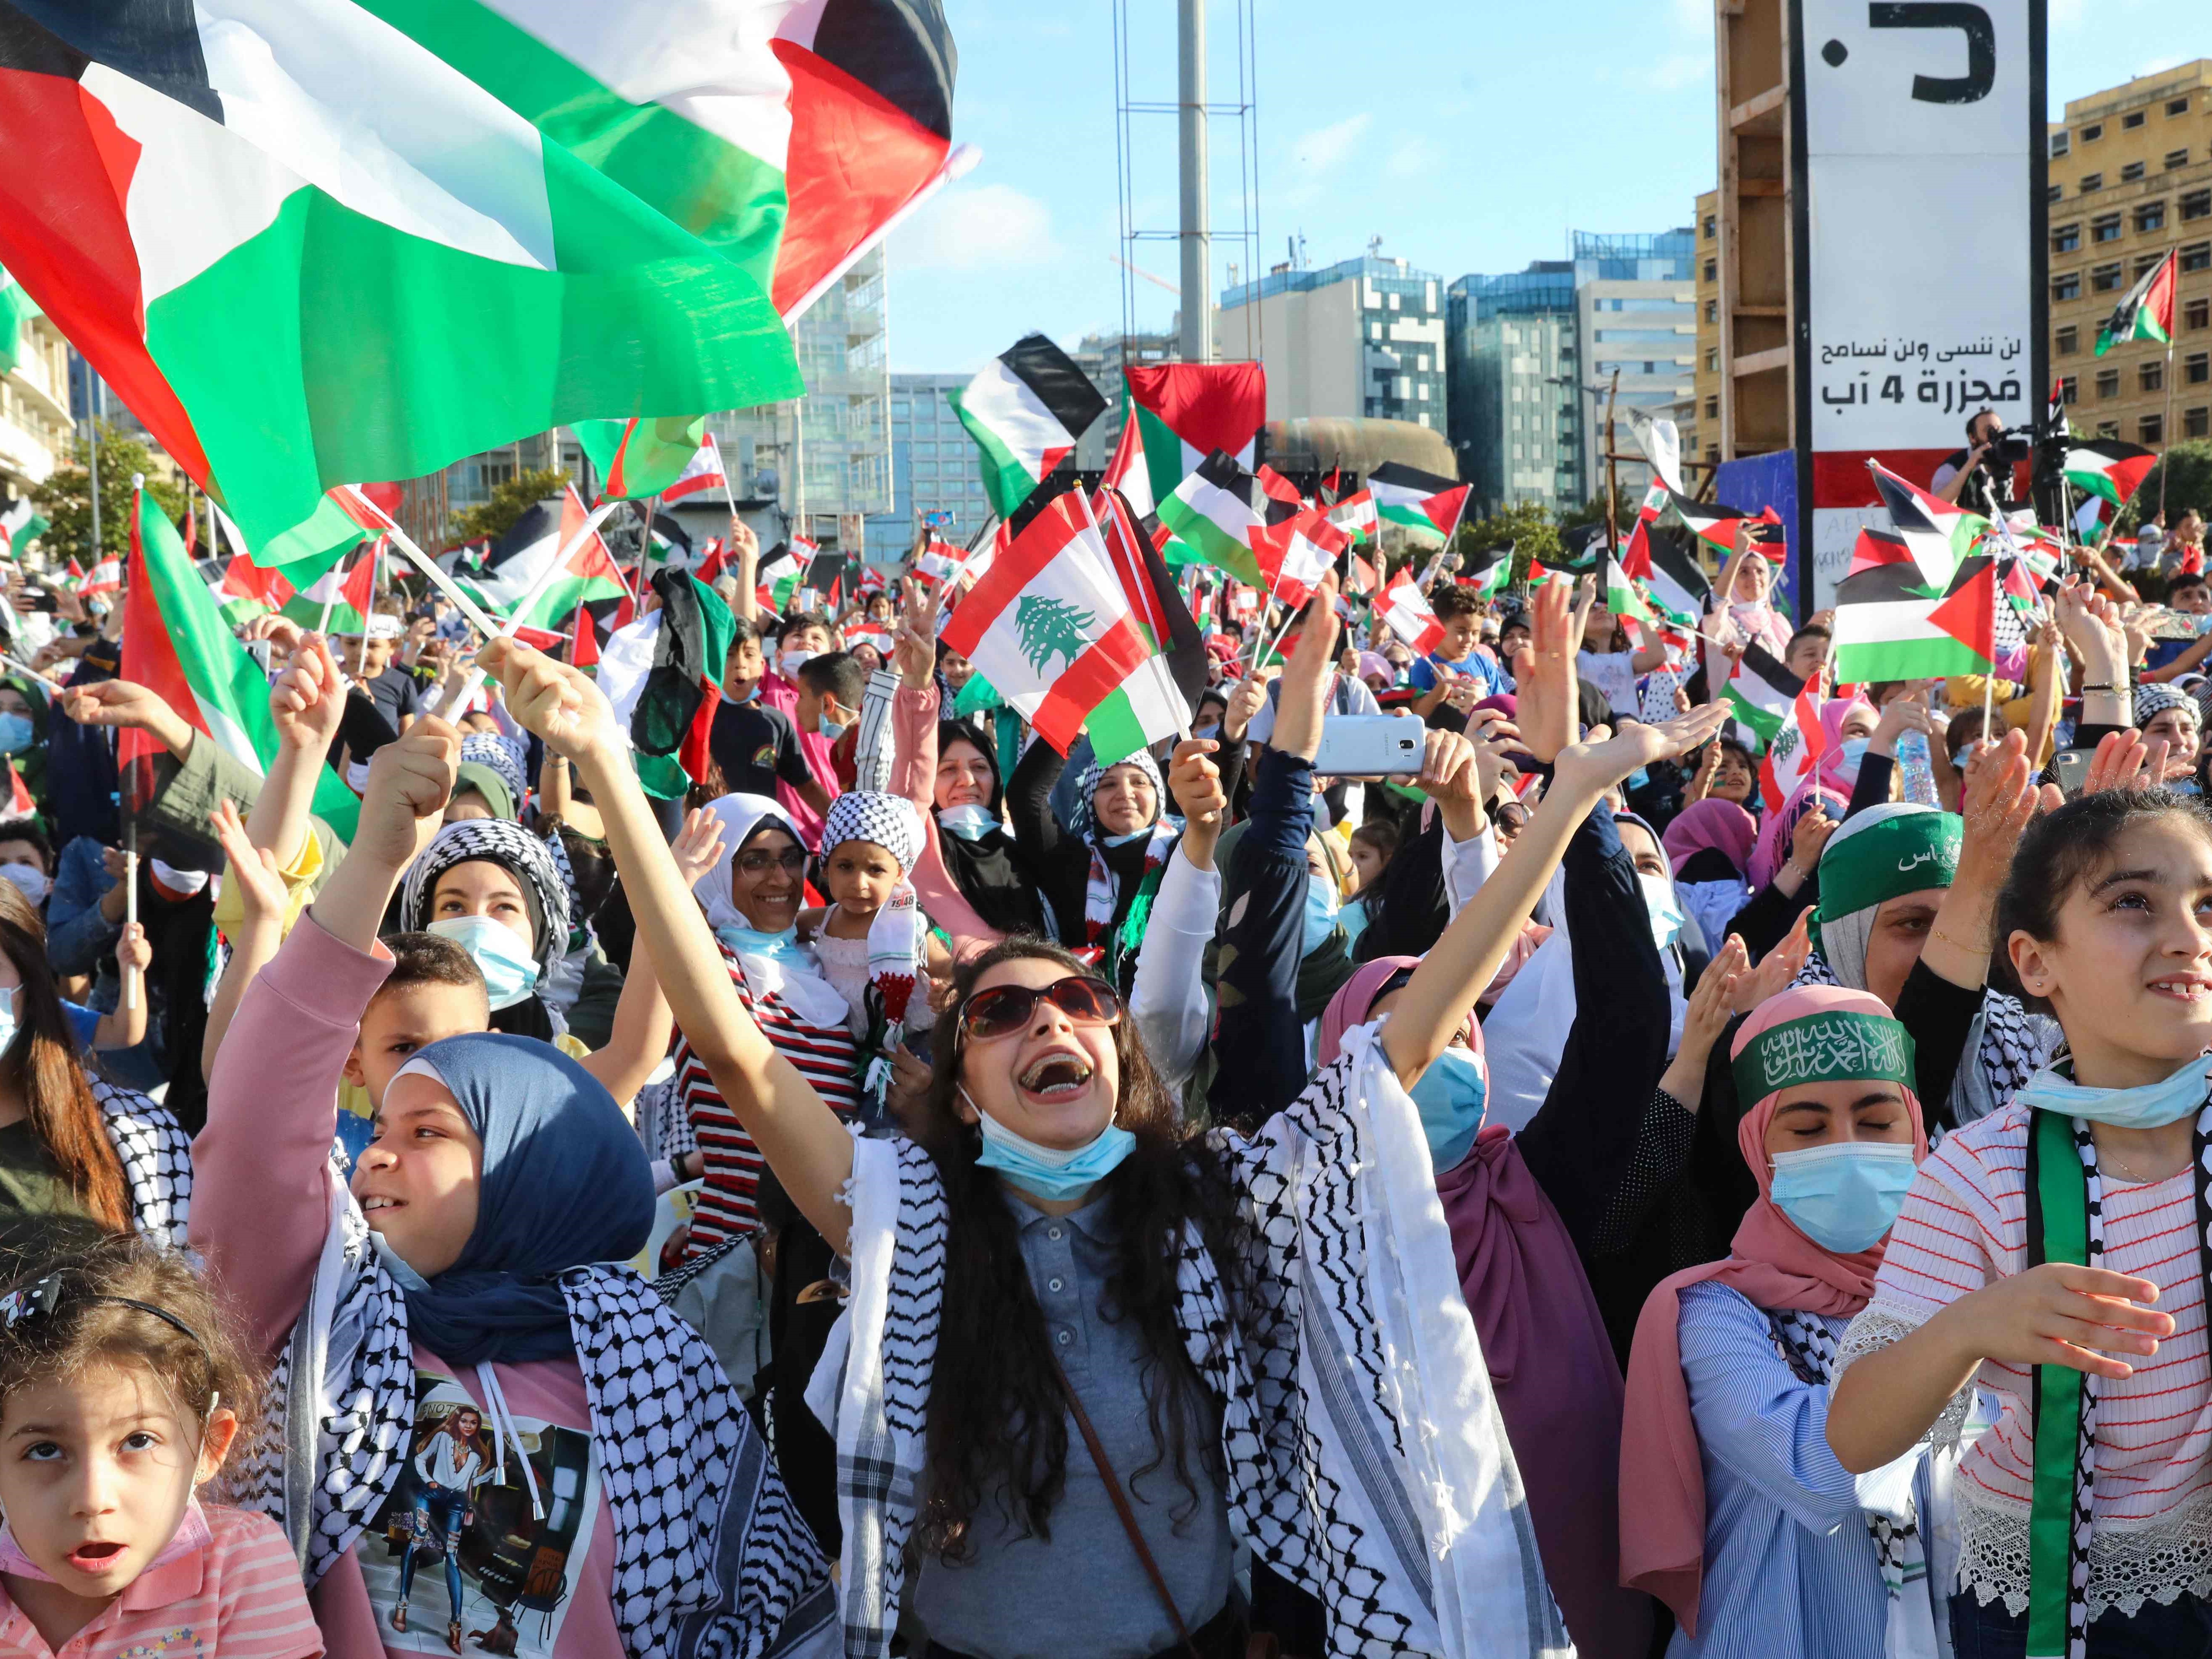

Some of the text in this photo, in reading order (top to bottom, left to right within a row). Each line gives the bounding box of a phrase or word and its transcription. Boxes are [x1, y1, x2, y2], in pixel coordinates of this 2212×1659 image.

[1822, 338, 2020, 364] لن ننسى ولن نسامح
[1823, 371, 1869, 414] آب
[1881, 376, 1904, 403] 4
